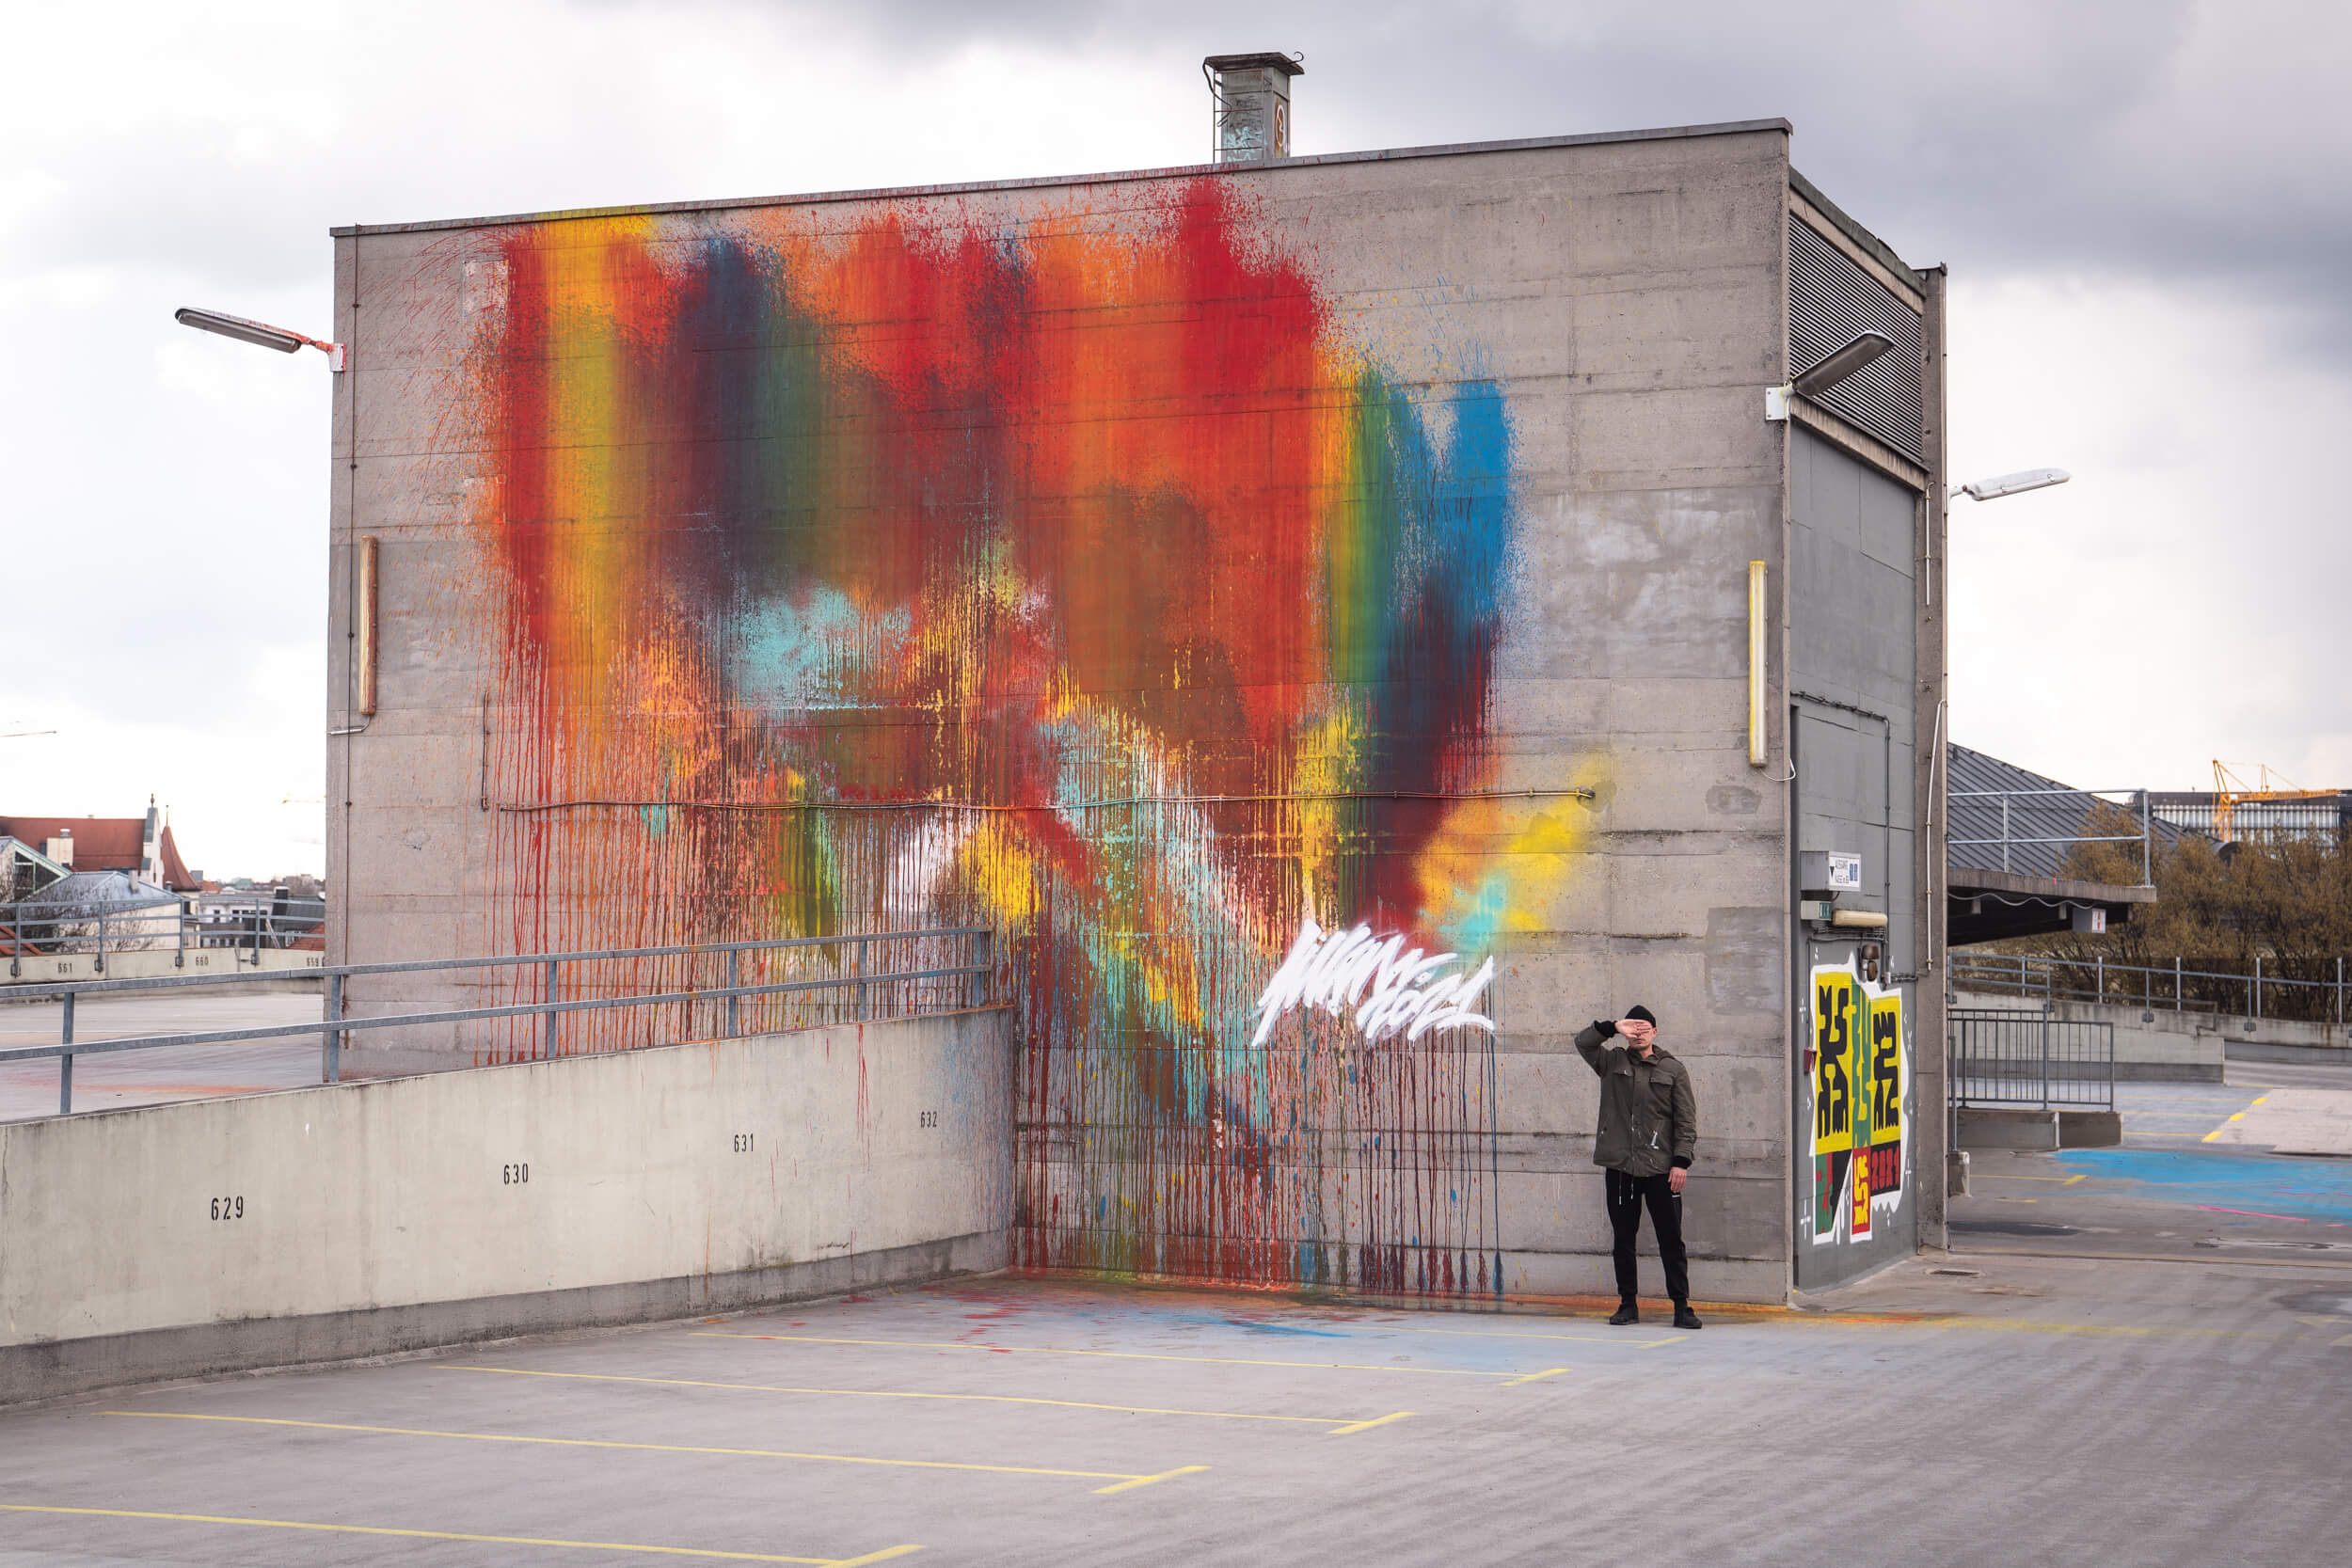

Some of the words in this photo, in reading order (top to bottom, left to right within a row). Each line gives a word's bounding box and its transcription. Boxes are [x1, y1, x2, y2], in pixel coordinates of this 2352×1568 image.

[920, 1111, 937, 1129] 632
[734, 1133, 754, 1152] 631
[503, 1163, 529, 1185] 630
[211, 1196, 244, 1221] 629
